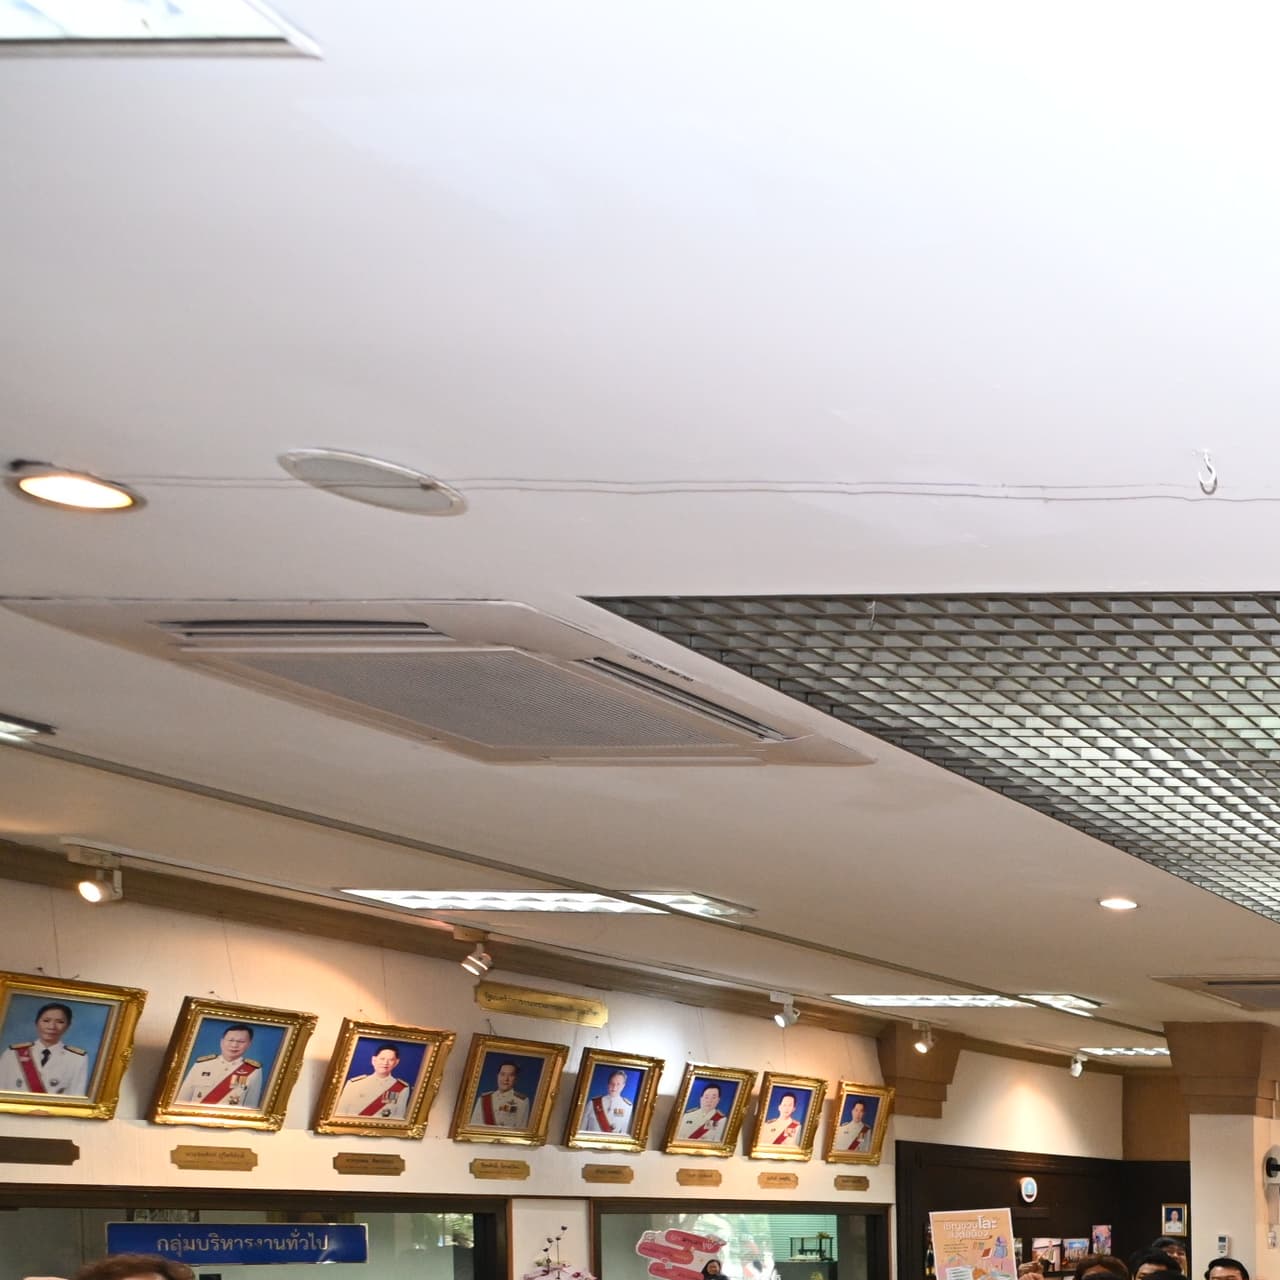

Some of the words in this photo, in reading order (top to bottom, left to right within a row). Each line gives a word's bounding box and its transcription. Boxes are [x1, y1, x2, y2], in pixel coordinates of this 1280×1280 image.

[156, 1230, 329, 1257] กลุ่มบริหารงานทั่วไป
